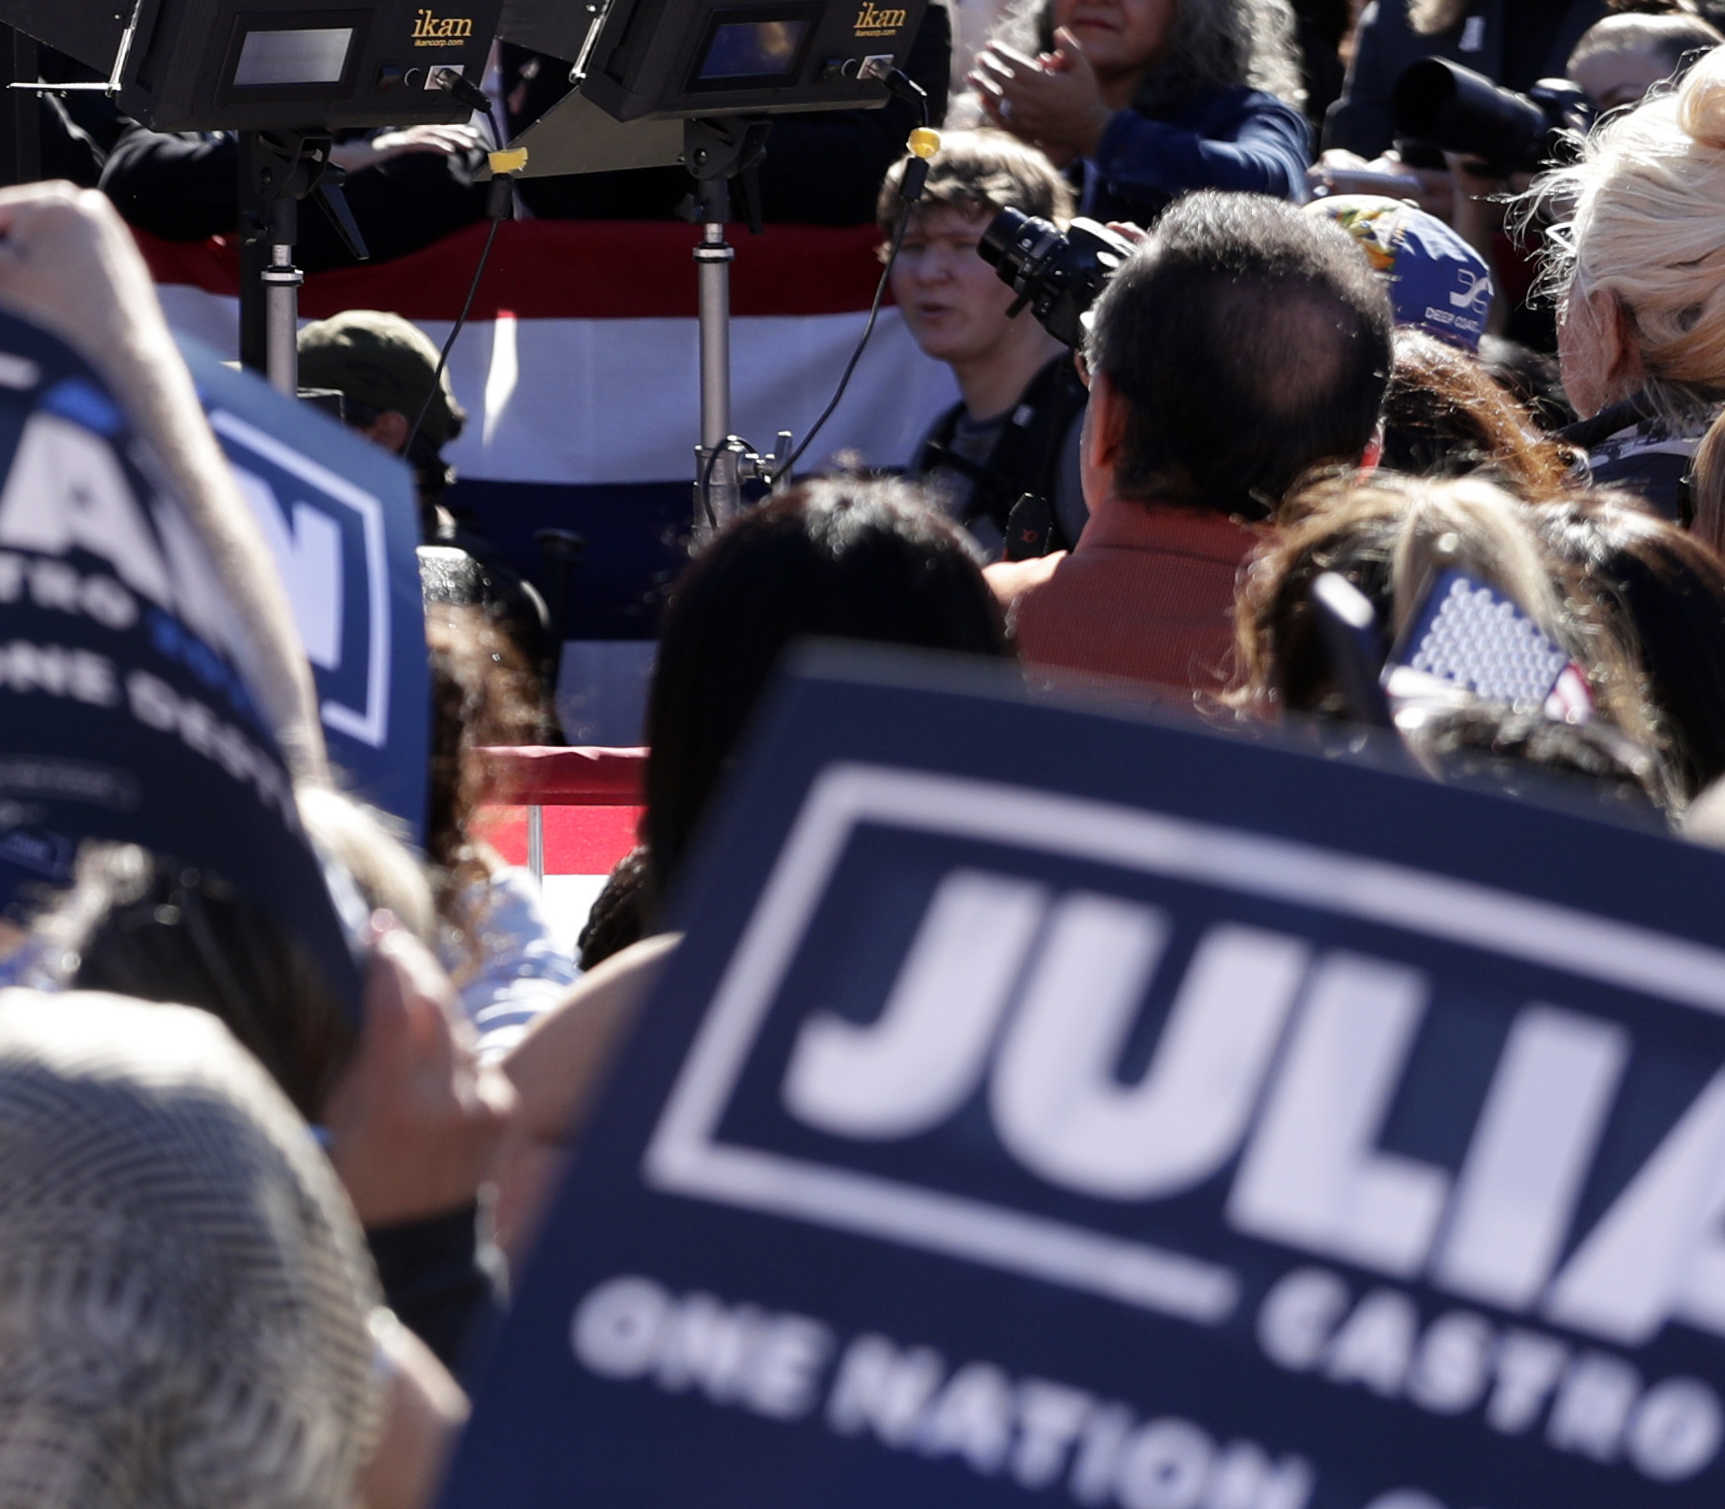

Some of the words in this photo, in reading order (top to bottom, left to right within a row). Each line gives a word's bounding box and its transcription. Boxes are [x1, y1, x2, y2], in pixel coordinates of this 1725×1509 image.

[411, 9, 473, 37] ikan
[853, 1, 906, 28] ikan
[1425, 306, 1454, 325] DEEP
[570, 1276, 835, 1422] ONE
[1254, 1265, 1723, 1483] CASTRO
